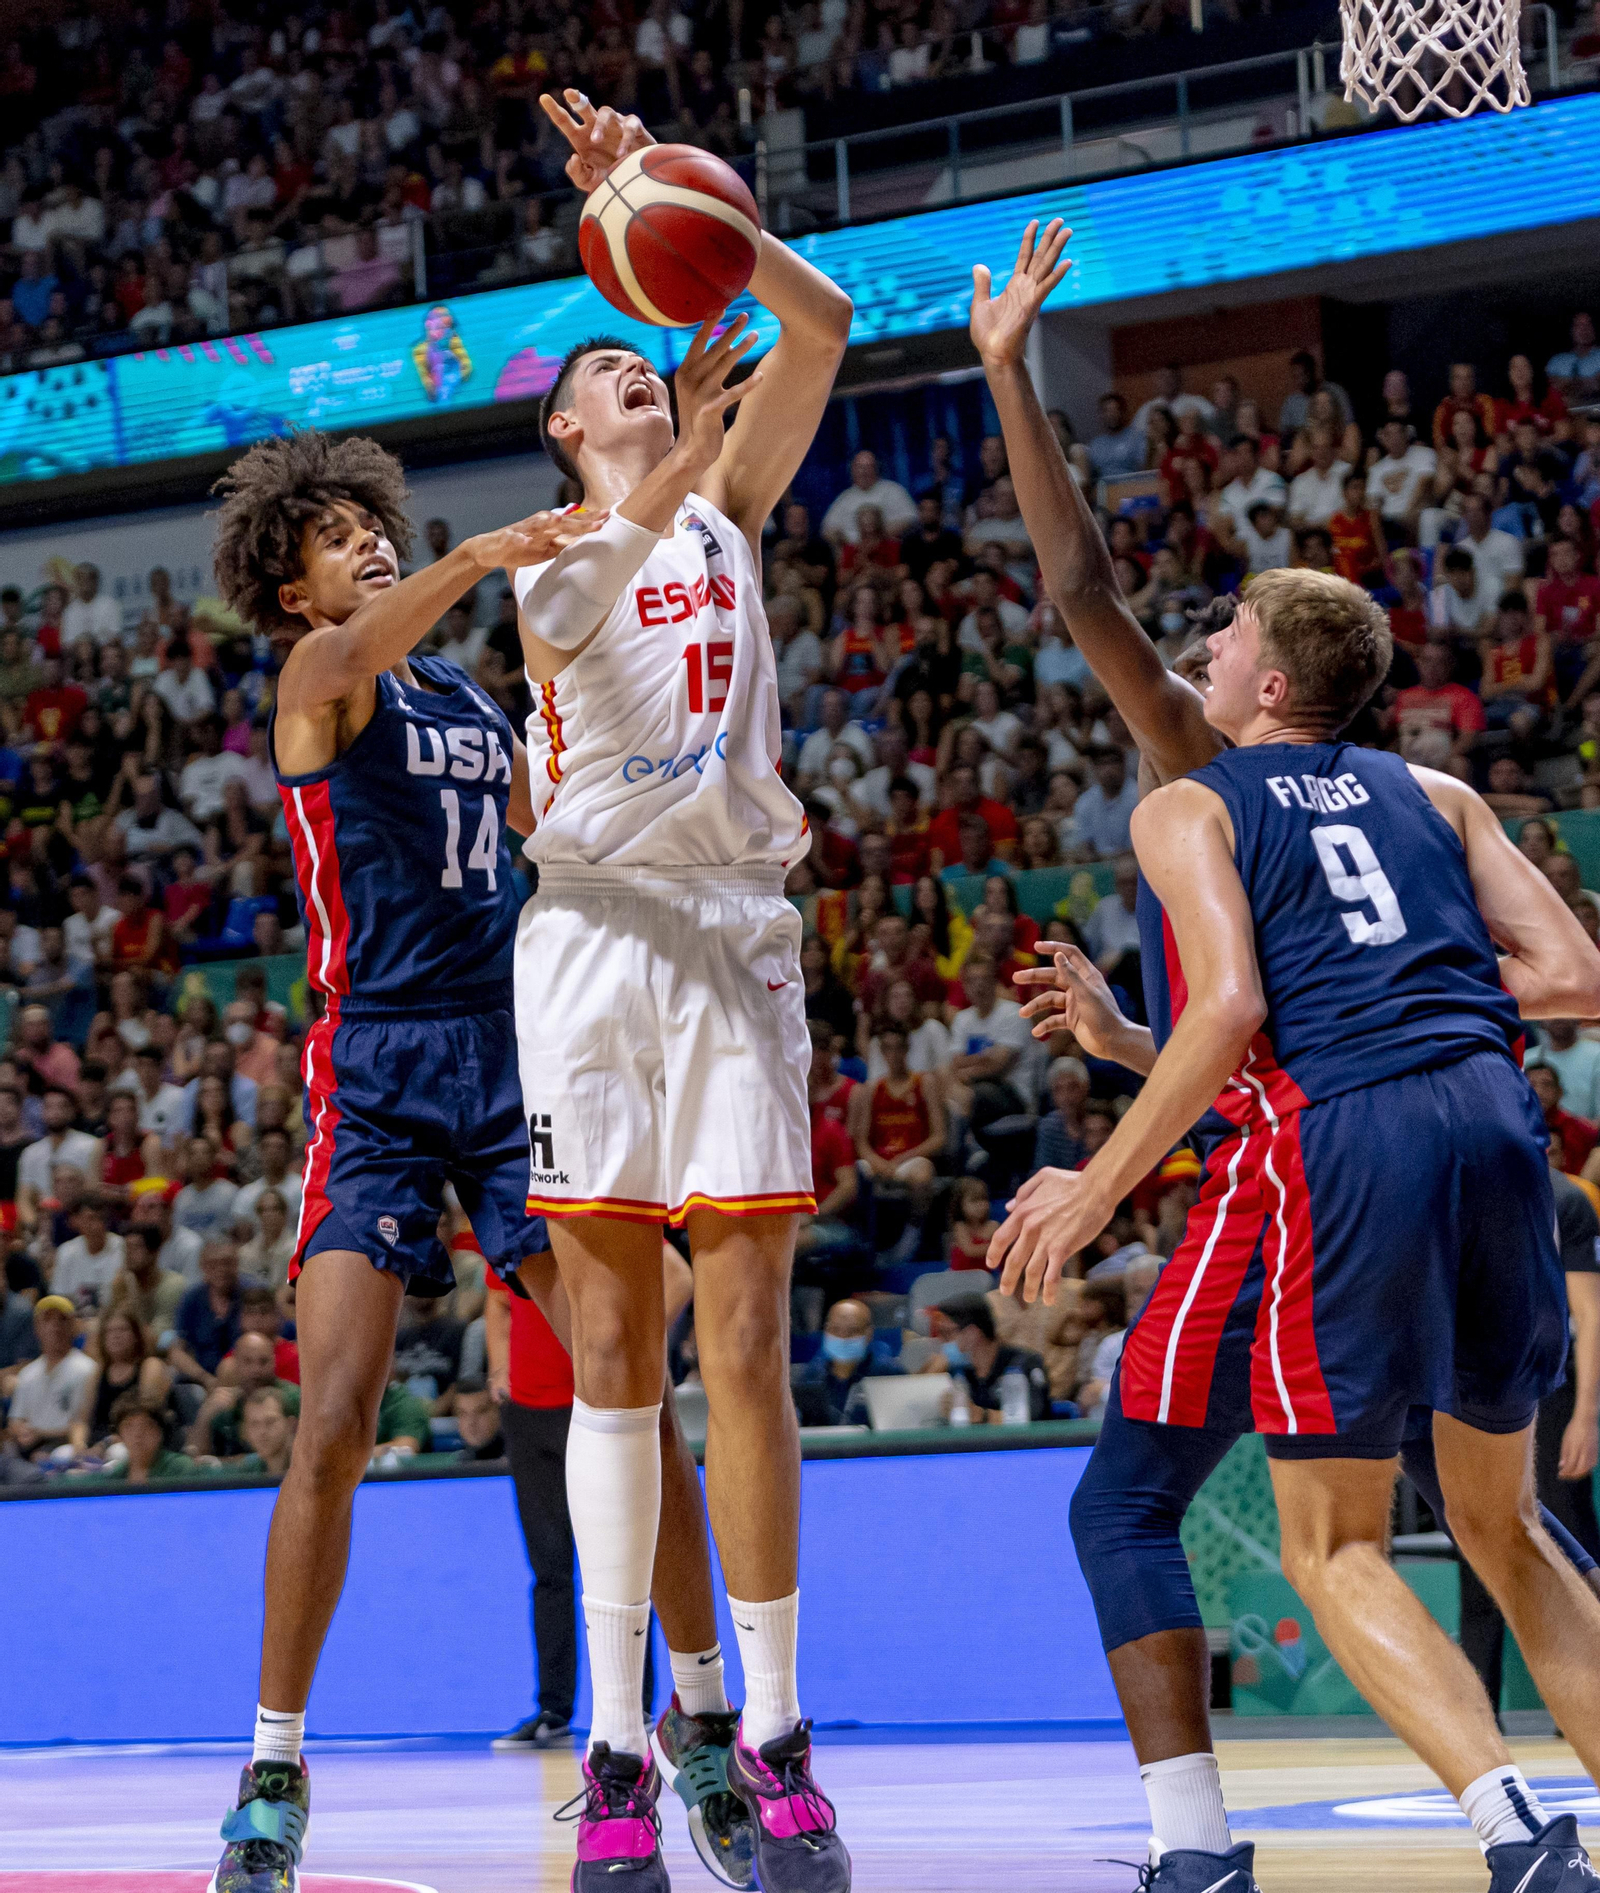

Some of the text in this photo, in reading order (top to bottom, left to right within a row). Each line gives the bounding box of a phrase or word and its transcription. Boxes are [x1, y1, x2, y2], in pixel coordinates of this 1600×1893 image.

[681, 641, 734, 714] 15
[406, 721, 512, 785] USA
[1265, 772, 1371, 814] FLAGG
[439, 788, 500, 892] 14
[1309, 823, 1408, 947] 9
